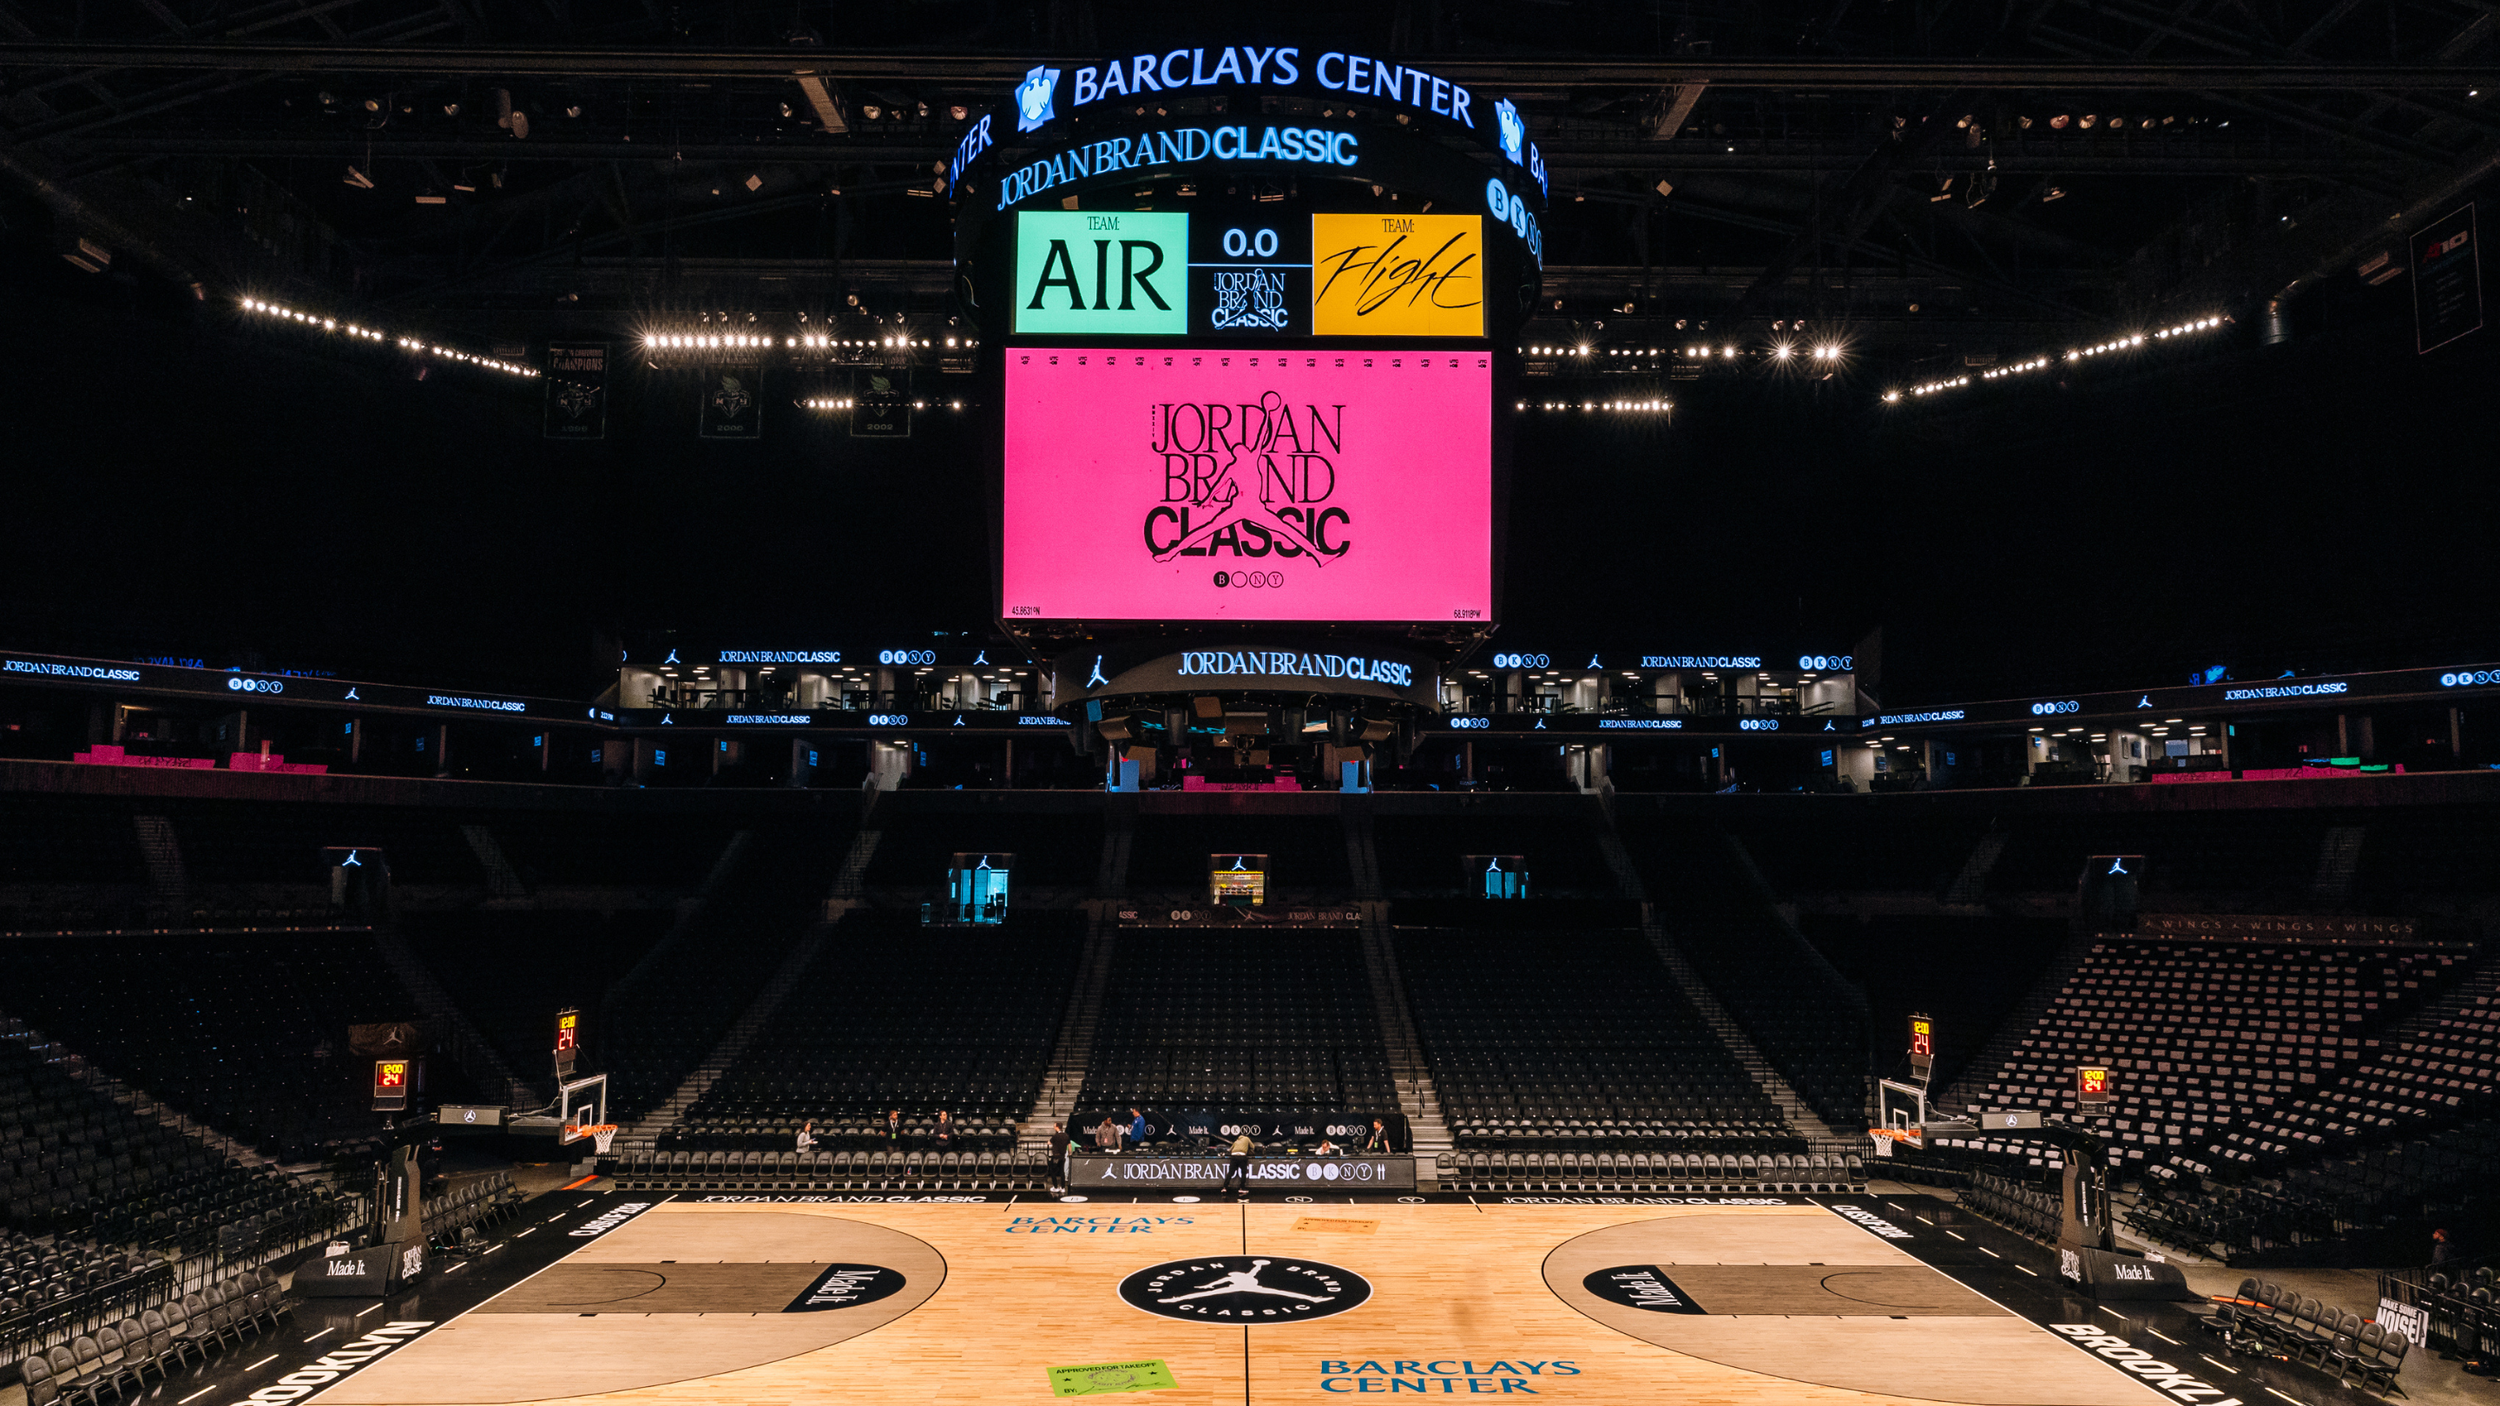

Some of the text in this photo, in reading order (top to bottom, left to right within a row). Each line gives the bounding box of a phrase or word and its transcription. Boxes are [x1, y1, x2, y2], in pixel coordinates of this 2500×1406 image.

[1073, 47, 1475, 129] BARCLAYS CENTER
[997, 126, 1358, 212] JORDAN BRAND CLASSIC
[1087, 216, 1120, 231] TEAM:
[1382, 218, 1415, 233] TEAM:
[1223, 228, 1279, 257] 0.0
[1026, 239, 1172, 310] AIR
[1213, 272, 1287, 291] JORDAN
[1314, 231, 1483, 317] Flight
[1151, 403, 1347, 454] JORDAN
[1143, 505, 1351, 559] CLASSIC
[1178, 651, 1412, 687] JORDAN BRAND CLASSIC
[2162, 920, 2412, 933] WINGS WINGS WINGS
[559, 1028, 574, 1050] 24
[1915, 1033, 1929, 1055] 24
[384, 1074, 398, 1085] 24
[2085, 1080, 2101, 1091] 24
[326, 1260, 366, 1276] Made It.
[1148, 1262, 1342, 1292] JORDAN BRAND
[2114, 1264, 2155, 1280] Made It.
[1179, 1304, 1310, 1316] CLASSIC
[2380, 1298, 2418, 1318] MAKE SOME
[1320, 1360, 1580, 1375] BARCLAYS
[1321, 1378, 1540, 1394] CENTER
